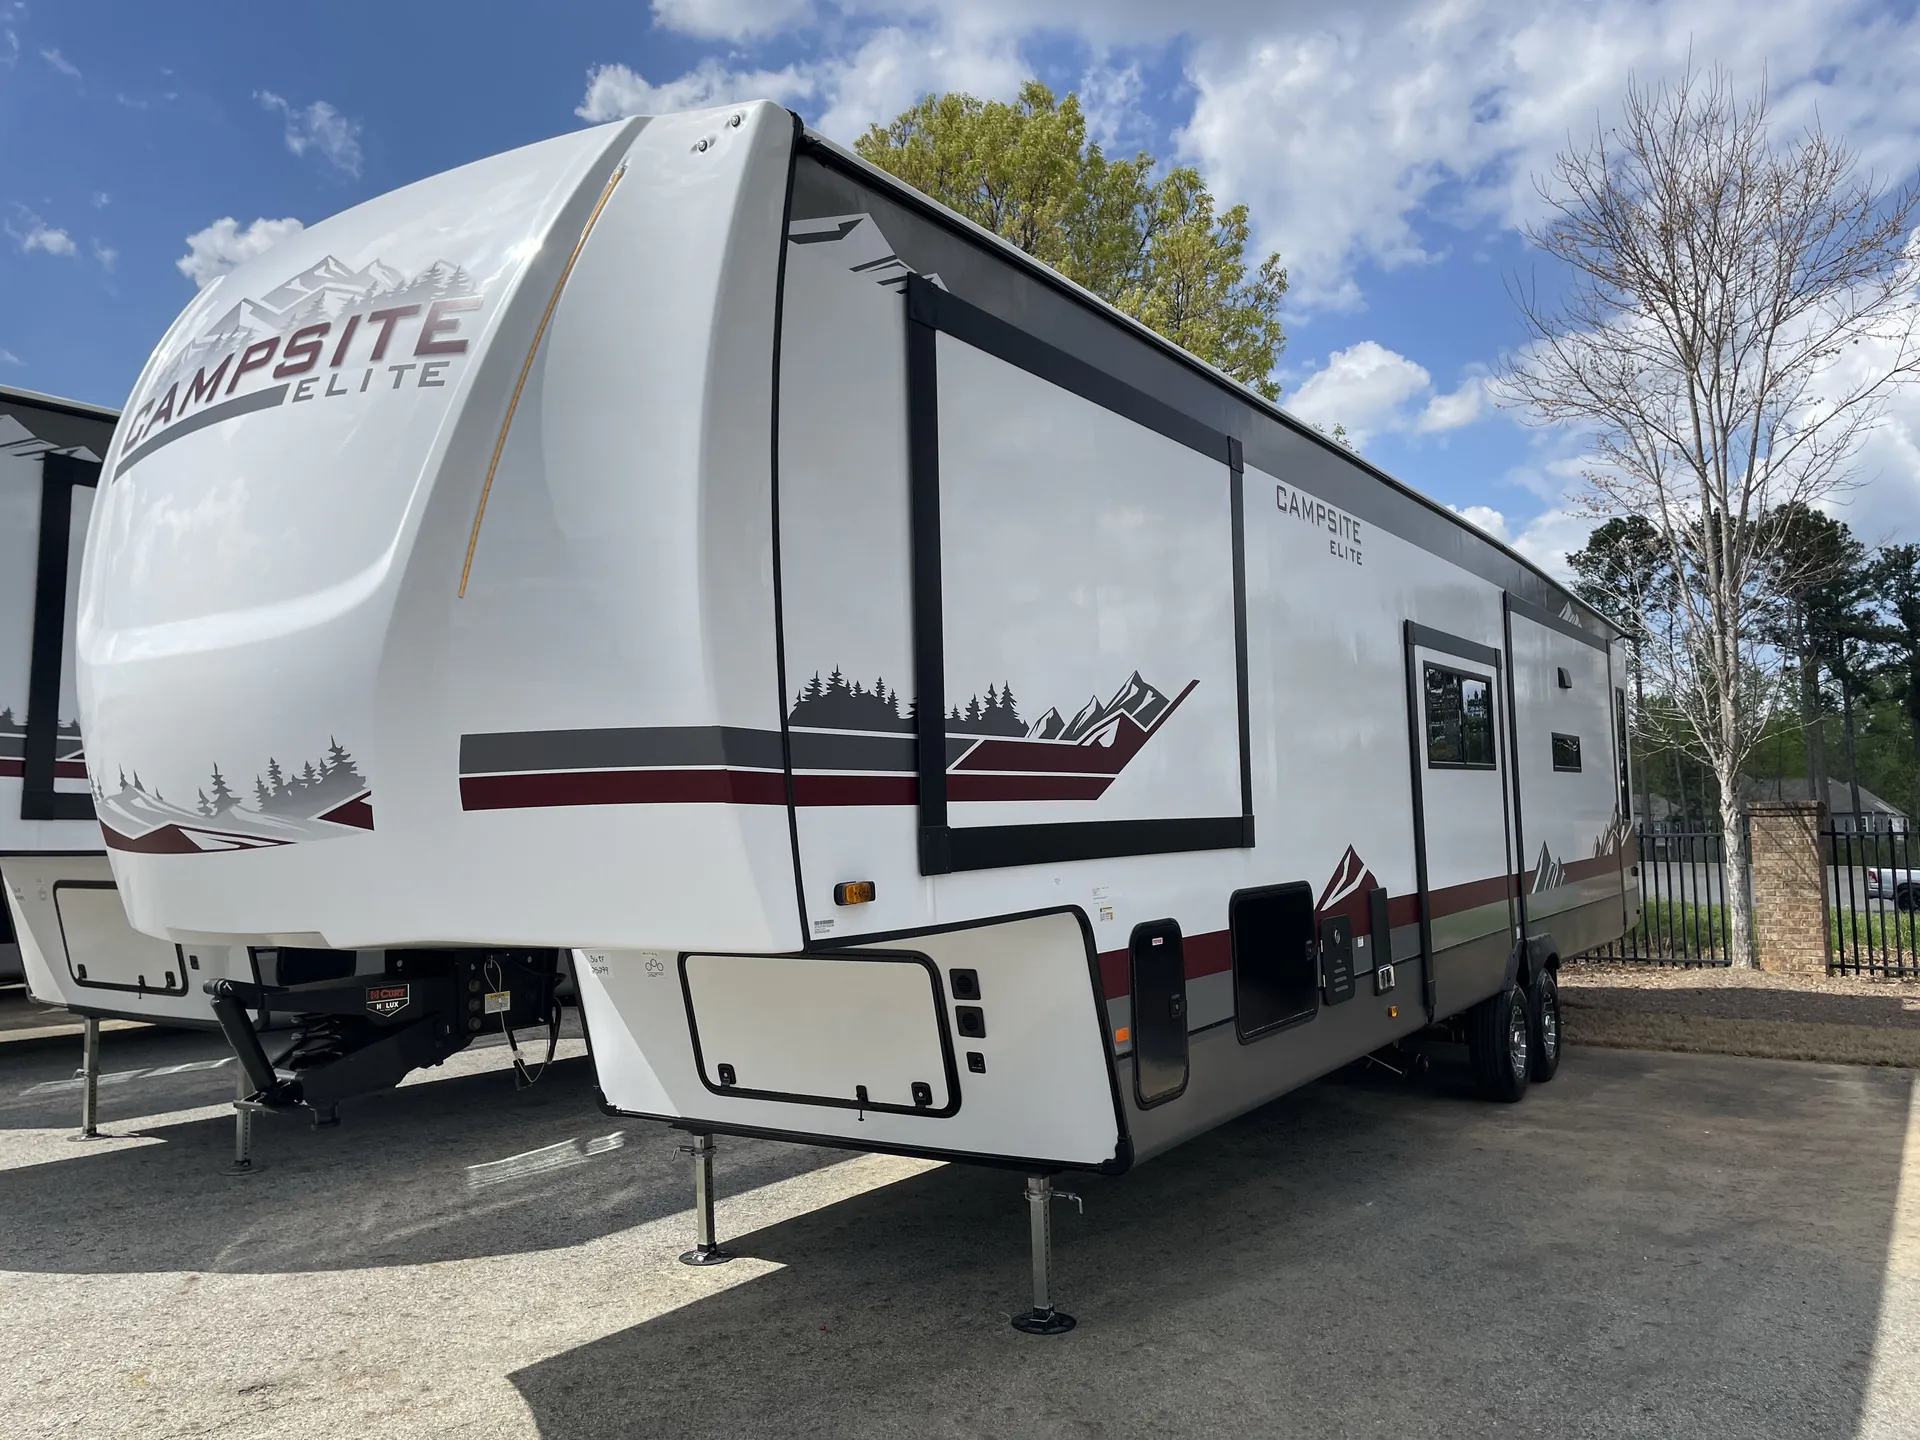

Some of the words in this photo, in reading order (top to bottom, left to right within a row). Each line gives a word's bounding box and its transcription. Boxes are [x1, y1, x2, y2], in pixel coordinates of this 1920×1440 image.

[120, 295, 485, 459] CAMPSITE
[291, 360, 451, 404] ELITE
[1276, 485, 1362, 545] CAMPSITE
[1330, 540, 1363, 566] ELITE
